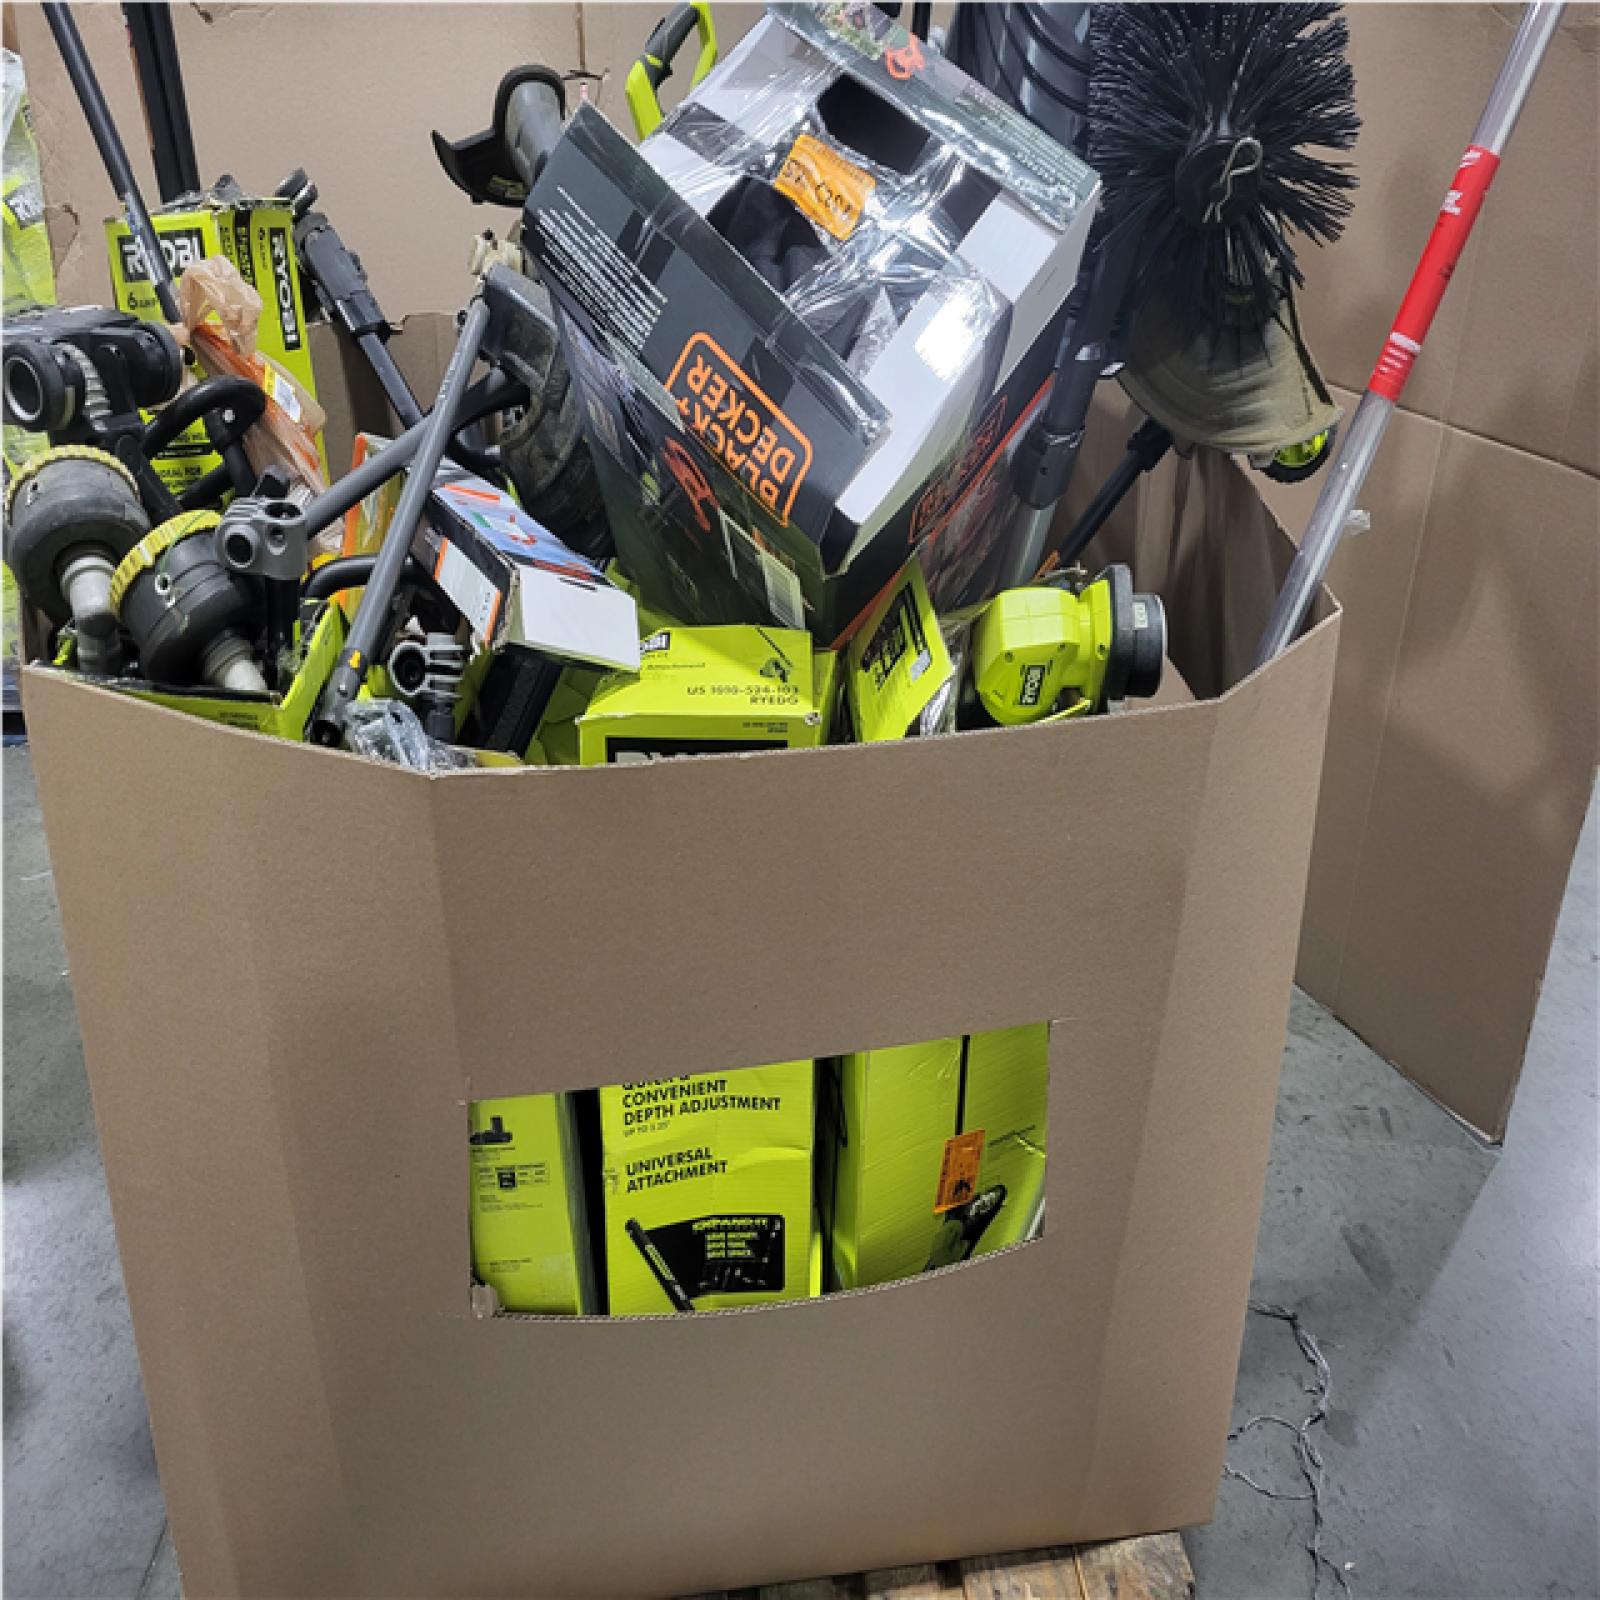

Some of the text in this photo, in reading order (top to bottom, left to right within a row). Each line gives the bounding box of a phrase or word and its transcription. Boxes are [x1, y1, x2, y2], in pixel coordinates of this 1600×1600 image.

[121, 236, 202, 274] ROBI
[273, 234, 298, 344] RYOBI
[686, 354, 797, 484] DECKER
[621, 1079, 728, 1109] CONVENIENT
[624, 1096, 782, 1127] DEPTH ADJUSTMENT
[625, 1146, 714, 1176] UNIVERSAL
[627, 1158, 728, 1194] ATTACHMENT
